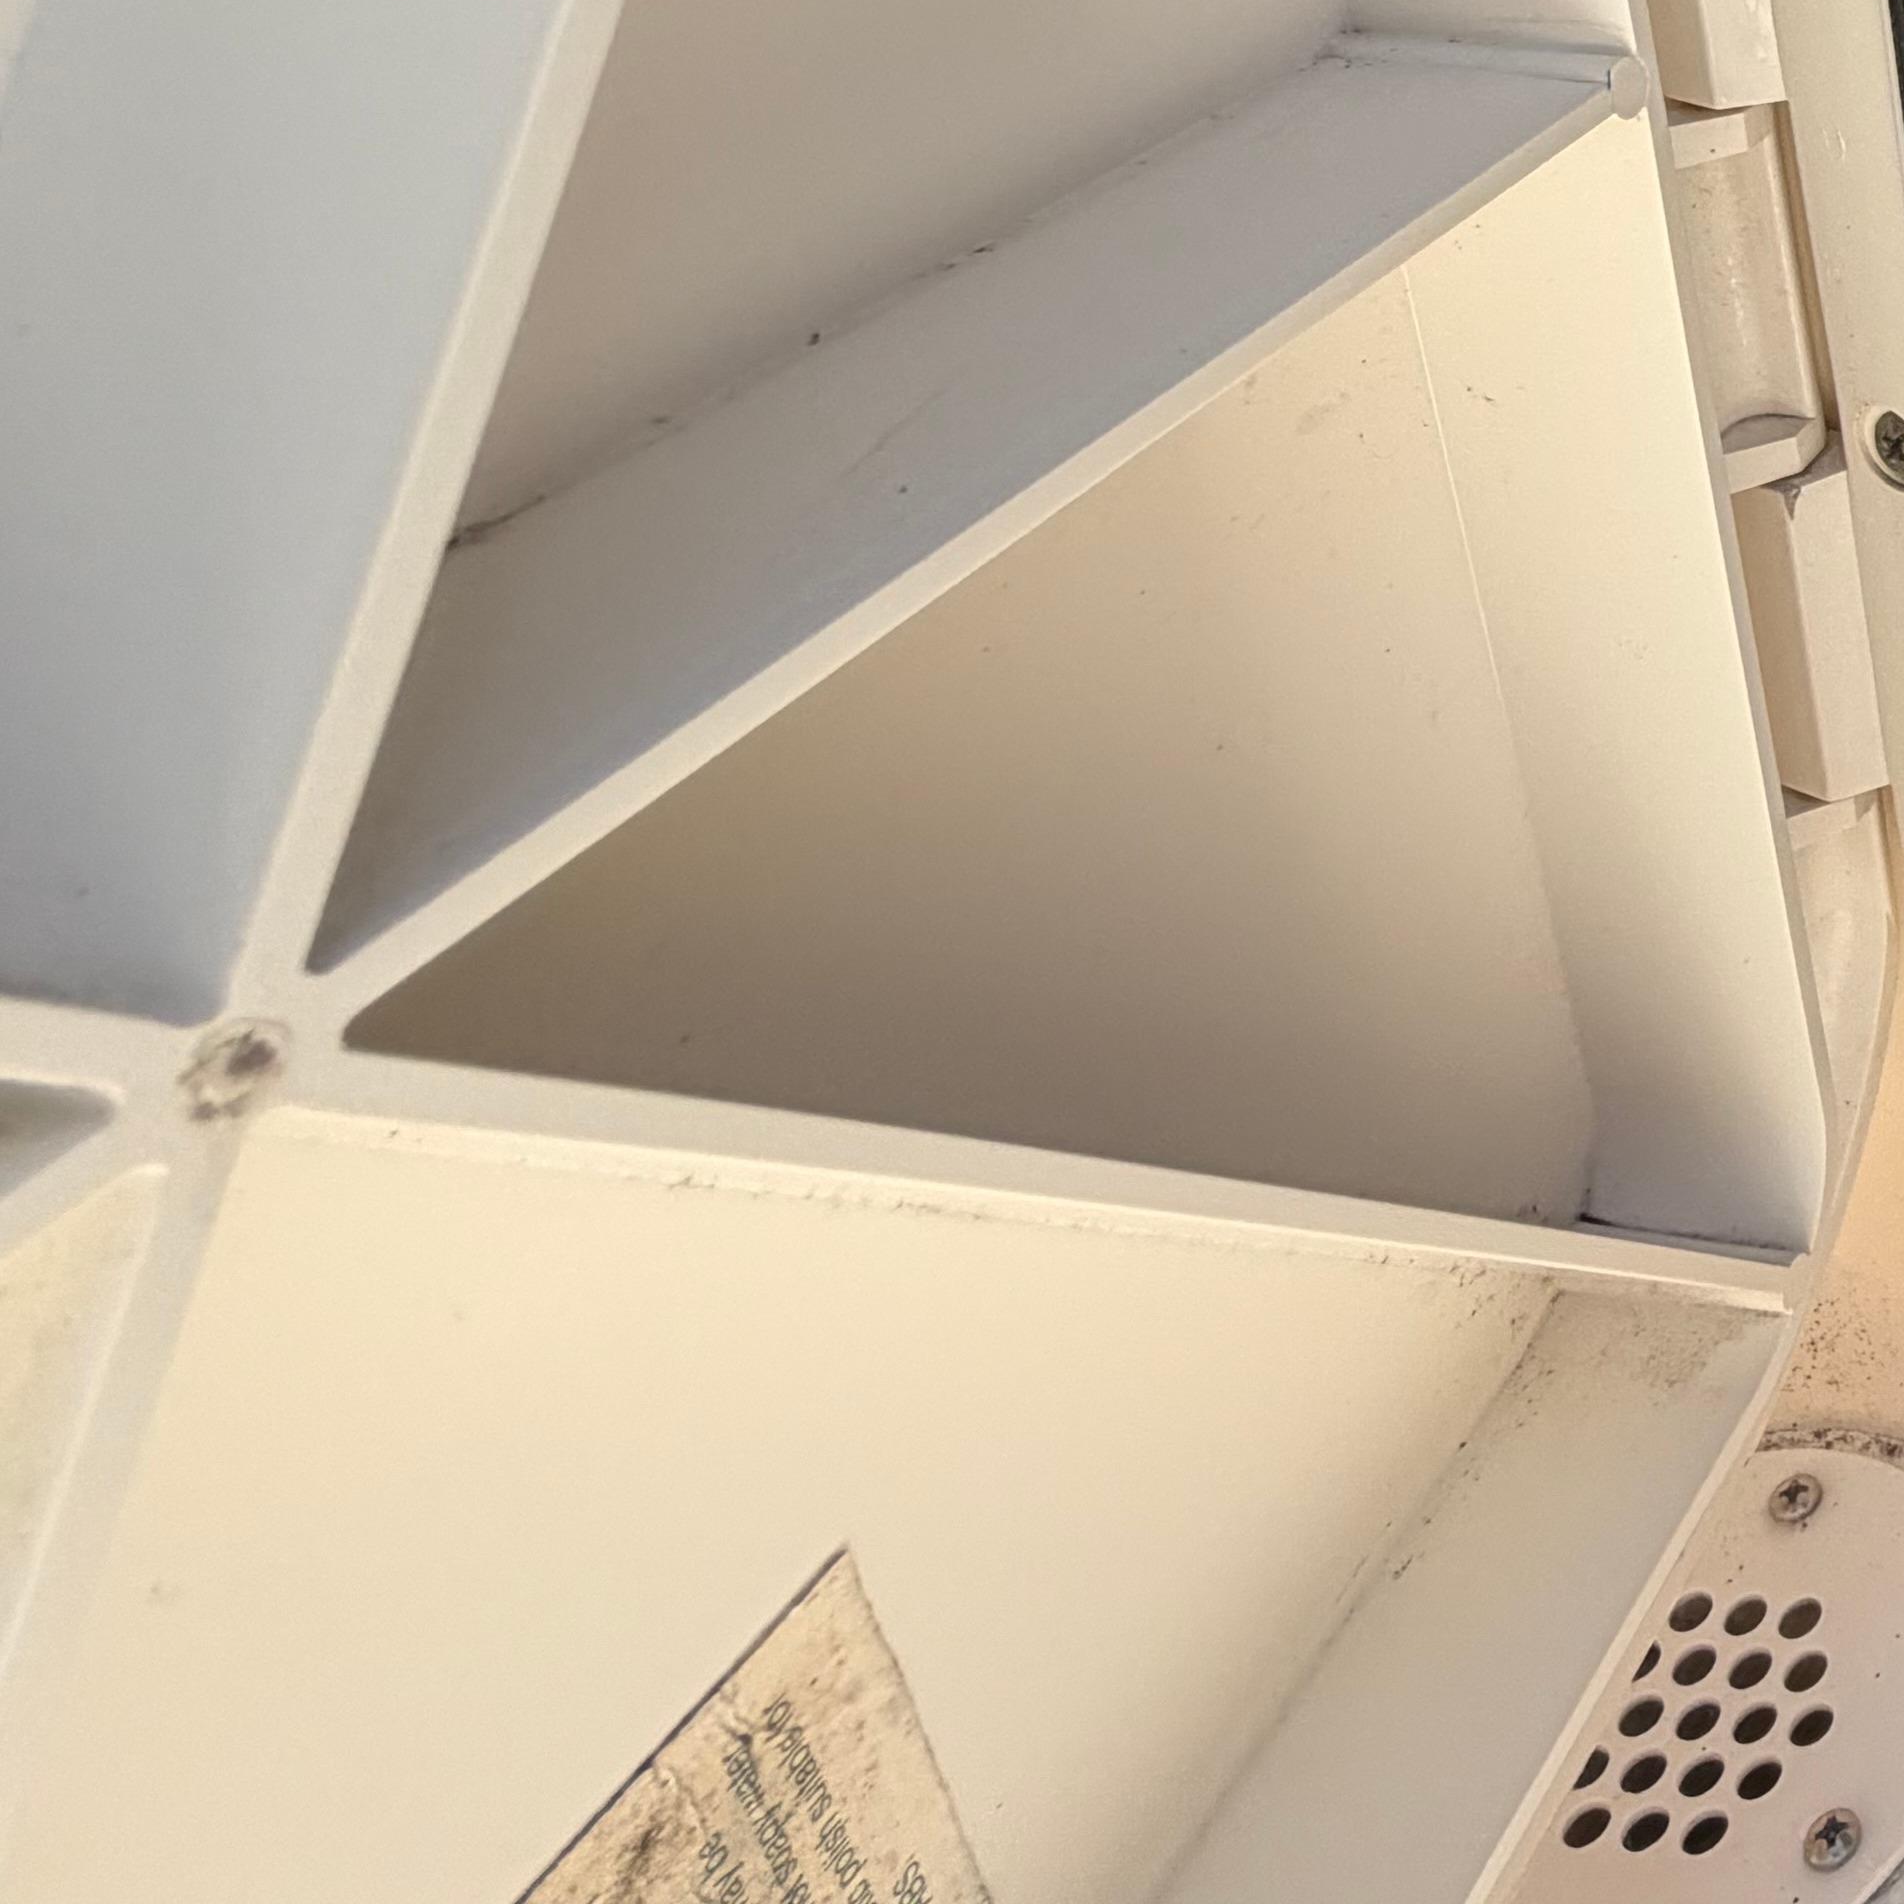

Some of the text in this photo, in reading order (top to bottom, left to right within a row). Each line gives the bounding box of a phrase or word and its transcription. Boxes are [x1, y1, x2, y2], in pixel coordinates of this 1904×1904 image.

[761, 1692, 793, 1742] for
[777, 1726, 833, 1823] suitable
[700, 1832, 729, 1882] be
[751, 1801, 798, 1889] soapy
[814, 1812, 868, 1889] polish
